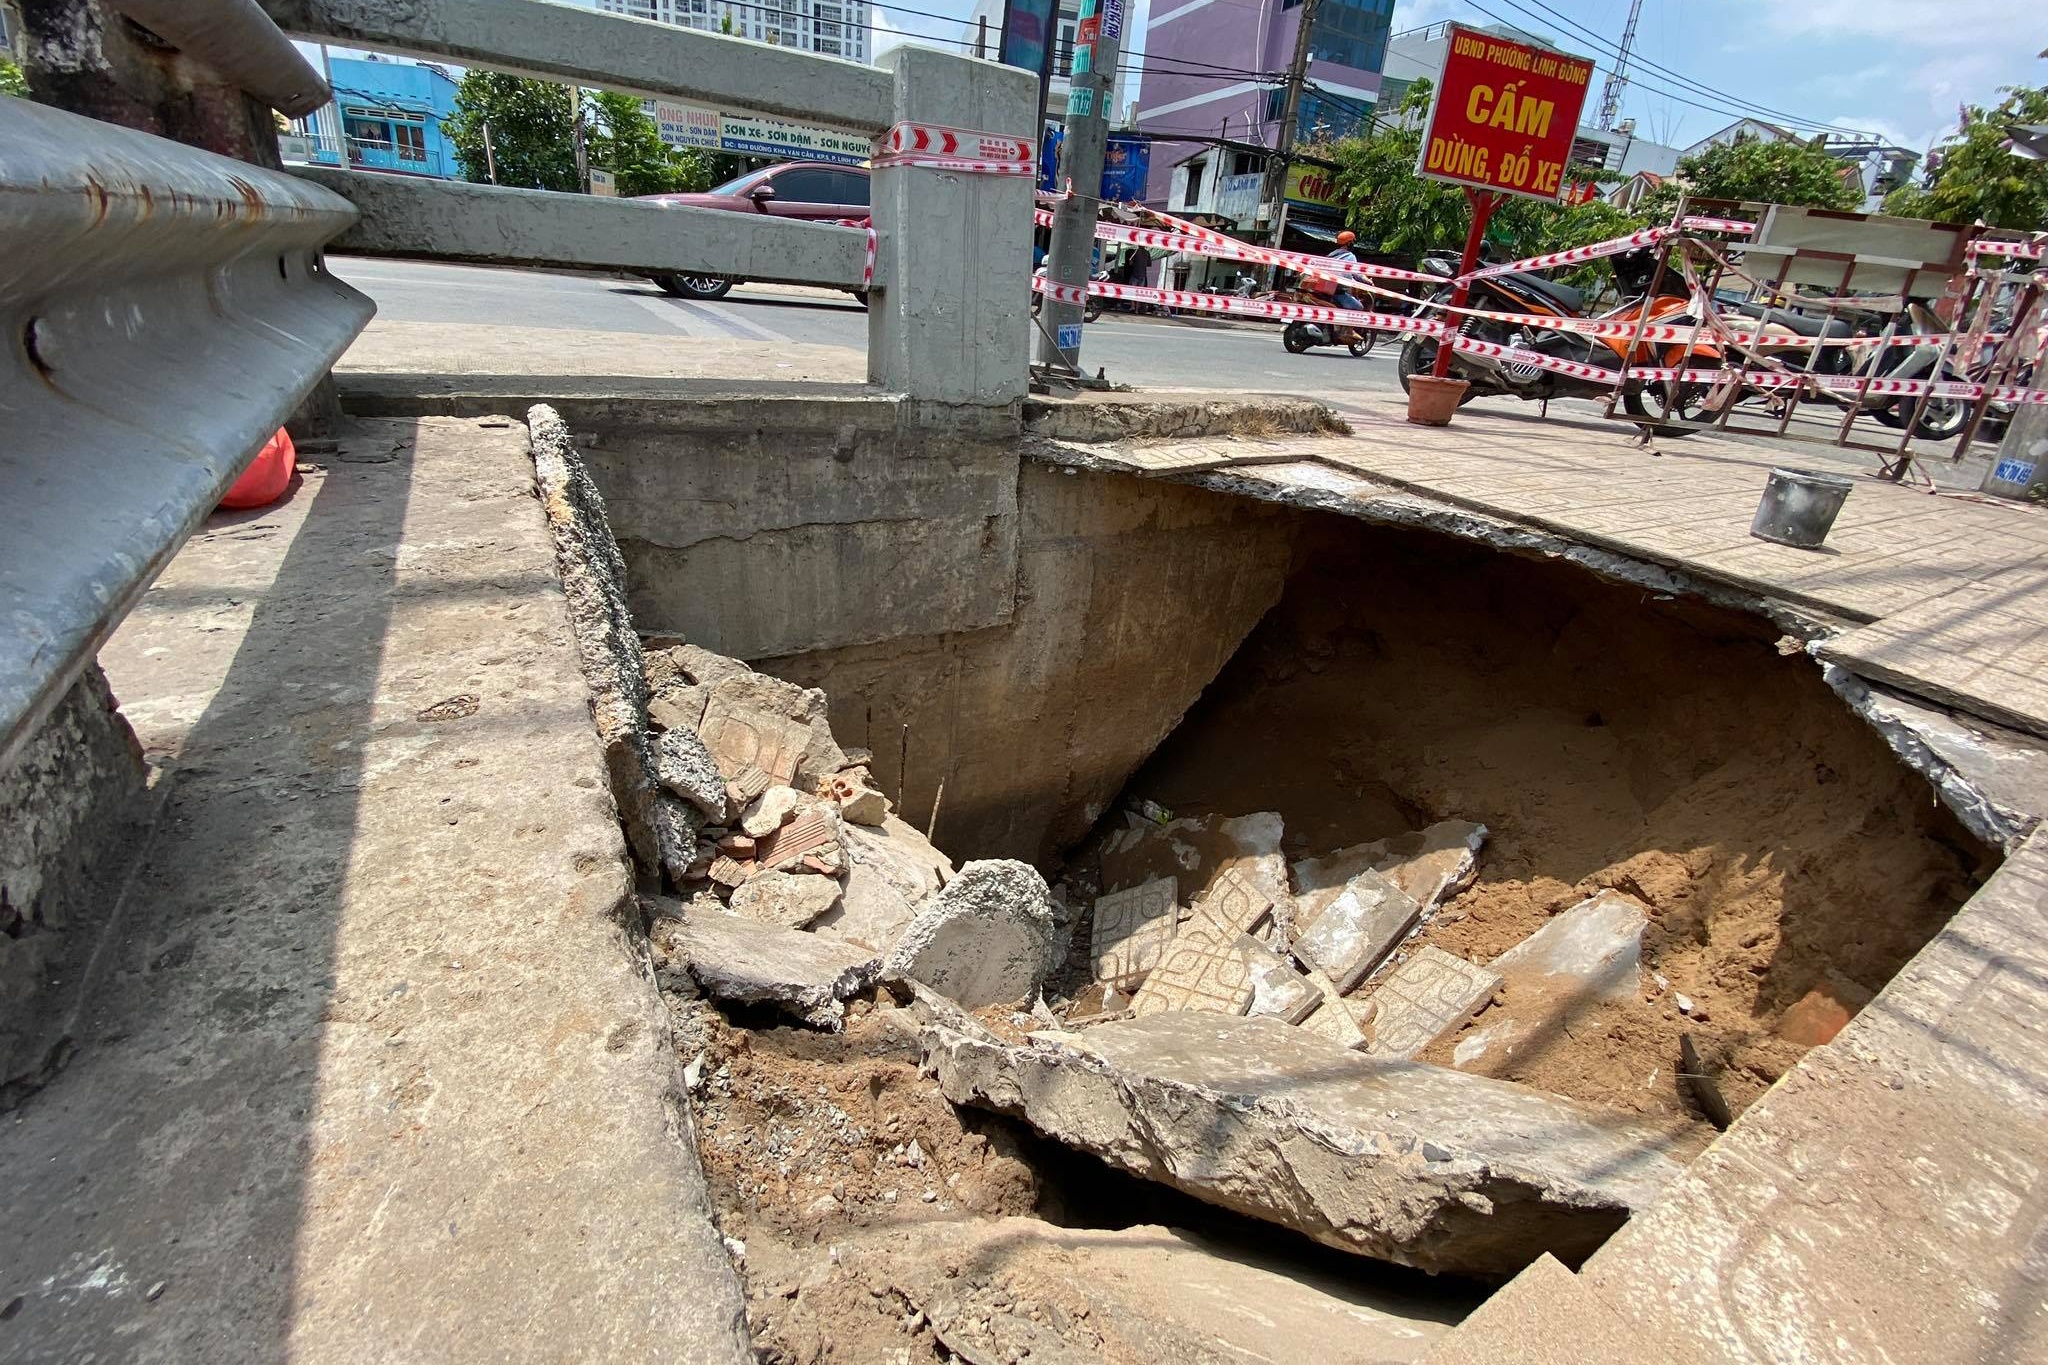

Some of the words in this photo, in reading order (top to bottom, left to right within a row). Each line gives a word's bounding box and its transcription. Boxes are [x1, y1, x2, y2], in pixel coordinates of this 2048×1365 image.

[1455, 36, 1485, 59] UBND
[1486, 45, 1532, 72] PHƯỜNG
[1532, 56, 1559, 78] LINH
[1558, 62, 1588, 86] ĐÔNG
[1466, 80, 1555, 139] CẤM
[725, 124, 746, 137] SƠN
[767, 131, 788, 142] SƠN
[821, 138, 840, 150] SƠN
[1428, 133, 1492, 184] DỪNG,
[1499, 145, 1534, 187] ĐỖ
[1532, 160, 1562, 193] XE
